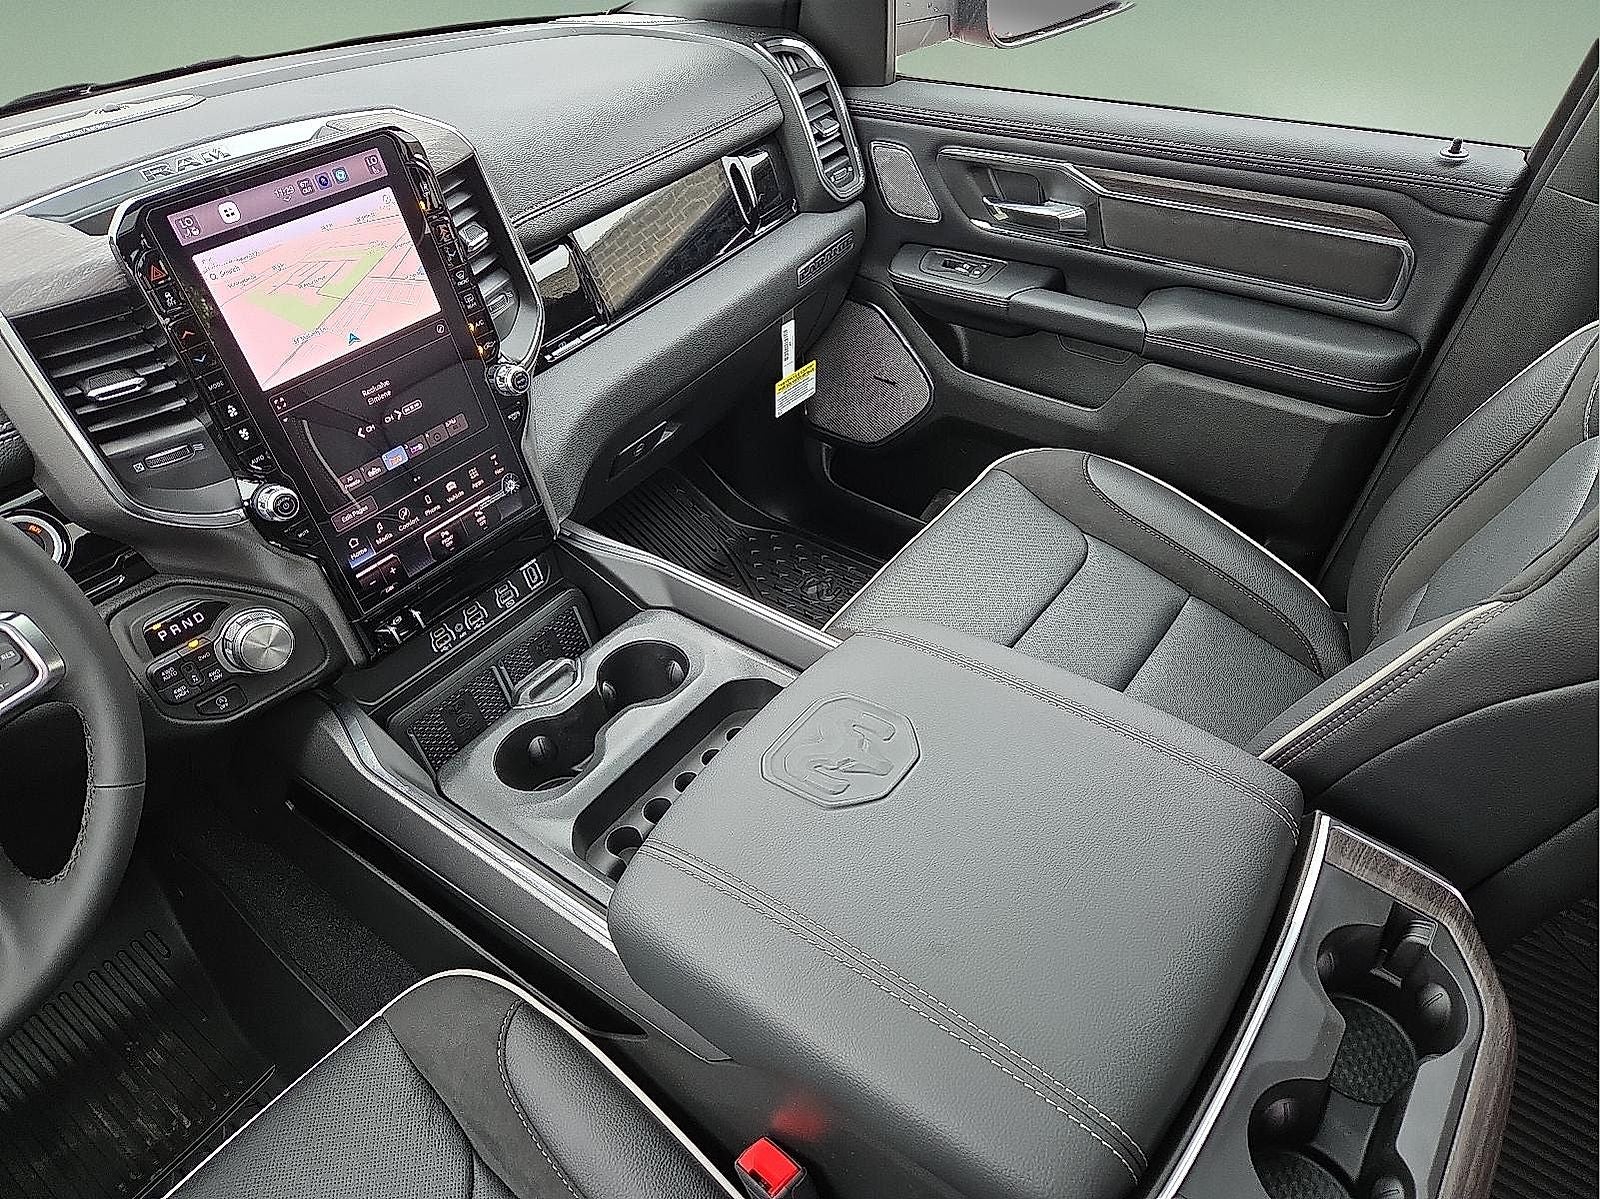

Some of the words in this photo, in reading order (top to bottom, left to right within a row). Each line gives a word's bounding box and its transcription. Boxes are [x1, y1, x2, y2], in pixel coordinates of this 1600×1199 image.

[139, 147, 232, 182] RAM
[366, 156, 378, 166] LO
[178, 216, 194, 229] LO
[475, 318, 485, 328] A/C
[207, 380, 225, 392] MODE
[251, 454, 265, 465] AUTO
[446, 490, 465, 503] Vehicle
[351, 505, 369, 518] Pages
[424, 504, 441, 516] Phone
[398, 516, 420, 531] Comfort
[375, 533, 393, 545] Media
[350, 548, 368, 560] Home
[162, 670, 178, 682] AUTO
[210, 672, 223, 683] LOW
